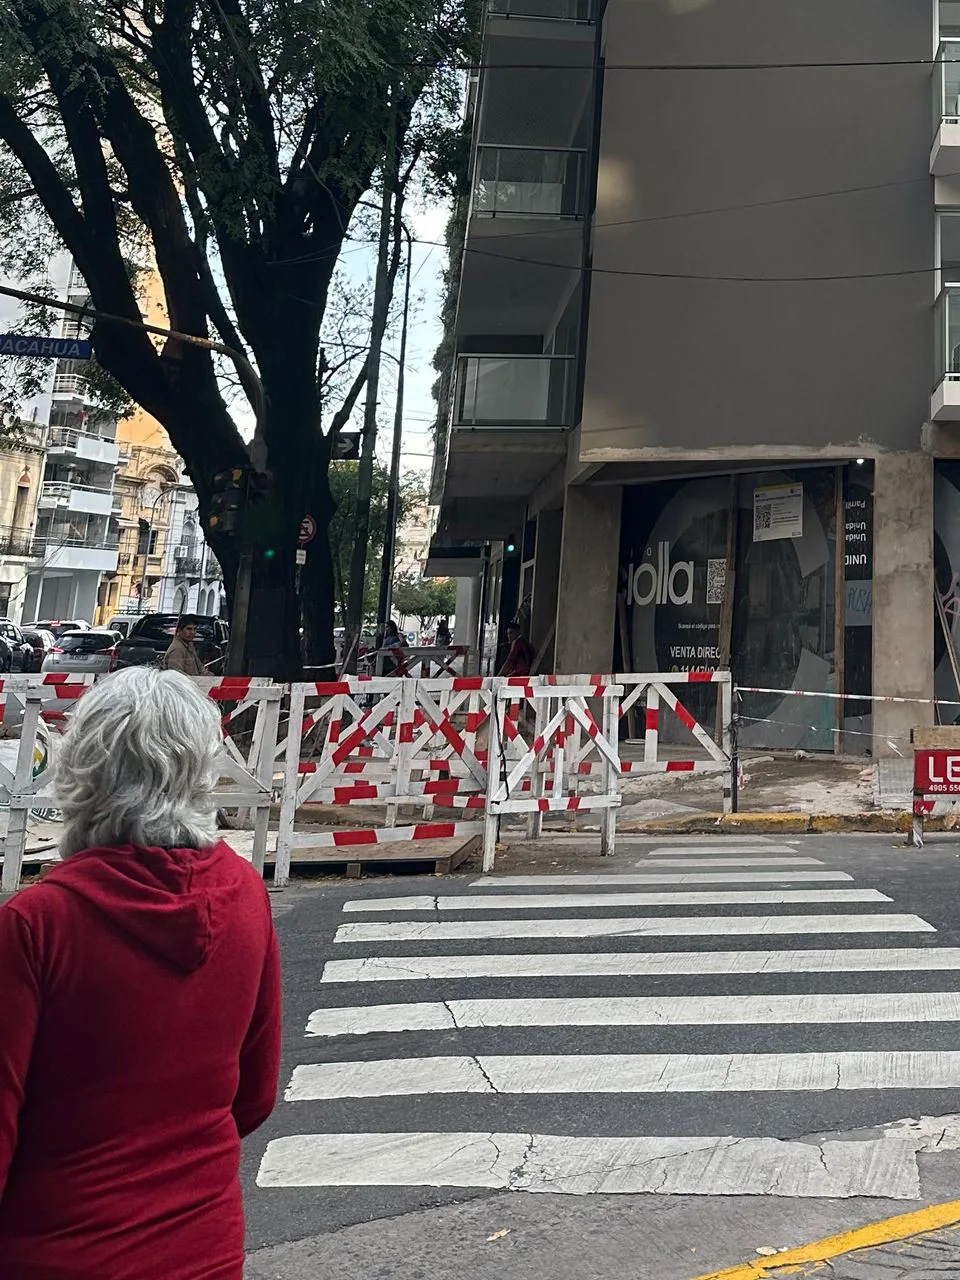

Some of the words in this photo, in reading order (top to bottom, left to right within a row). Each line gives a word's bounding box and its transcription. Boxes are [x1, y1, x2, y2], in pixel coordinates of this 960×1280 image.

[0, 339, 80, 356] ACAHUA
[670, 646, 696, 658] VENTA
[928, 784, 948, 792] 4905
